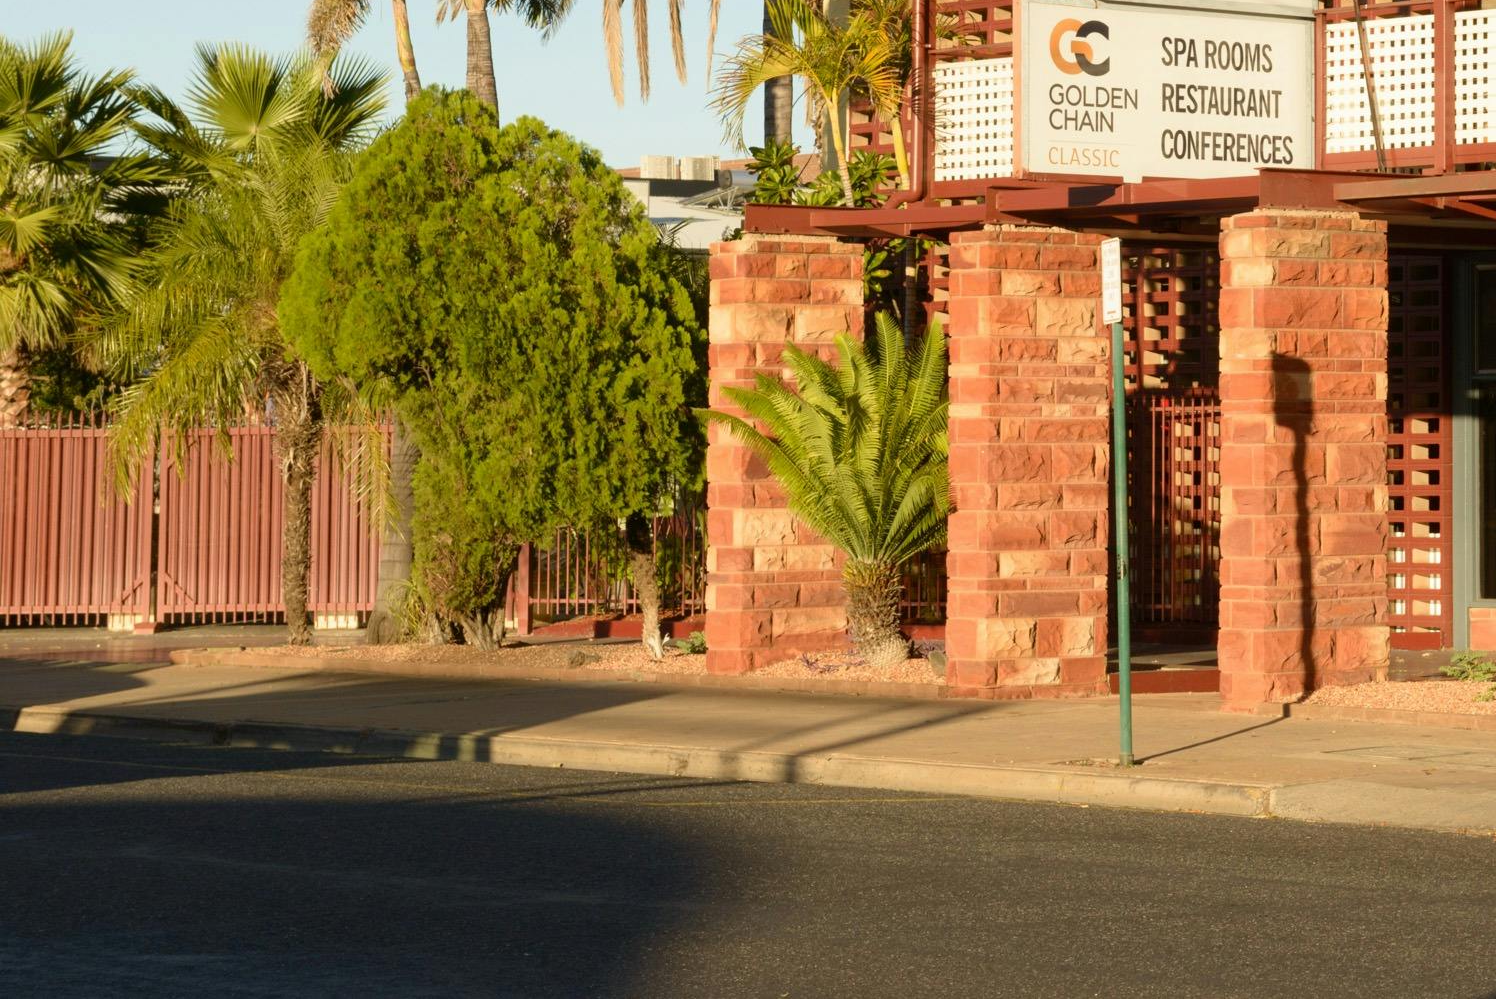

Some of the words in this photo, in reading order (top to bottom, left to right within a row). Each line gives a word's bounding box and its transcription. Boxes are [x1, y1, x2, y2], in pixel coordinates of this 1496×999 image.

[1161, 36, 1199, 68] SPA
[1204, 40, 1273, 73] ROOMS
[1049, 83, 1139, 110] GOLDEN
[1161, 83, 1282, 119] RESTAURANT
[1049, 108, 1114, 133] CHAIN
[1048, 146, 1120, 168] CLASSIC
[1161, 129, 1294, 165] CONFERENCES
